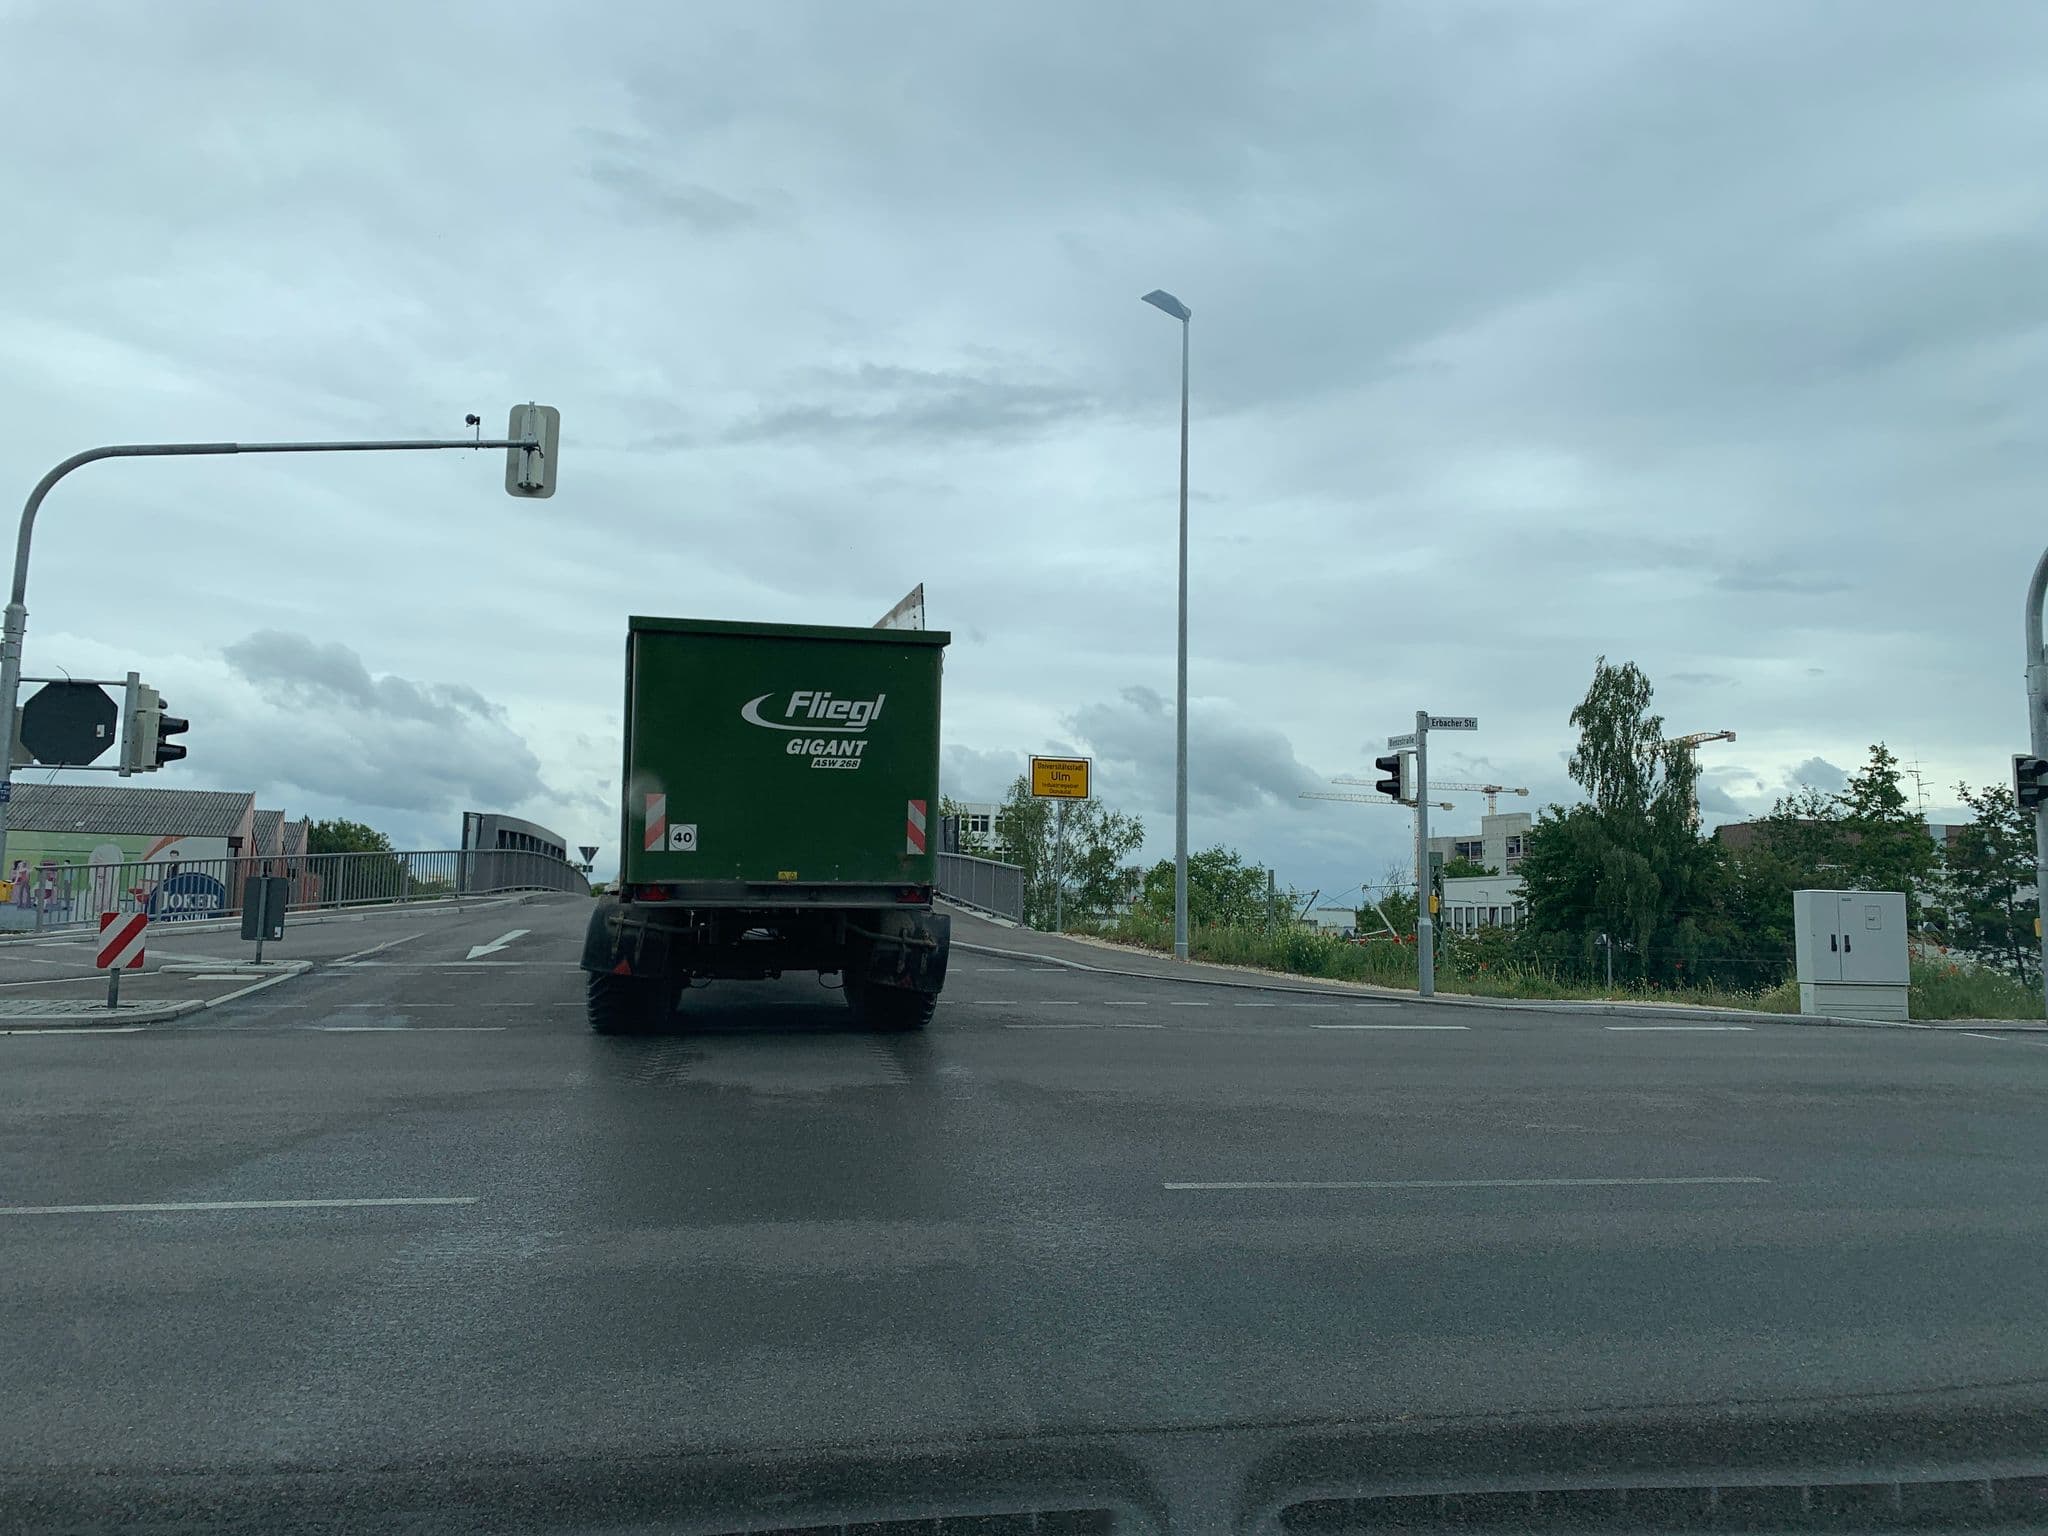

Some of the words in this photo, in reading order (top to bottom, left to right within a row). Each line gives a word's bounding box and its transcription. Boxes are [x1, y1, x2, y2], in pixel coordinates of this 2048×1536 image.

[785, 691, 886, 727] Fliegl
[1431, 718, 1462, 728] Erbacher
[1464, 718, 1478, 728] Str.
[786, 738, 868, 757] GIGANT
[813, 759, 838, 768] ASW
[839, 759, 858, 768] 268
[1050, 771, 1071, 782] Ulm
[673, 832, 692, 843] 40
[160, 891, 219, 910] JOKER
